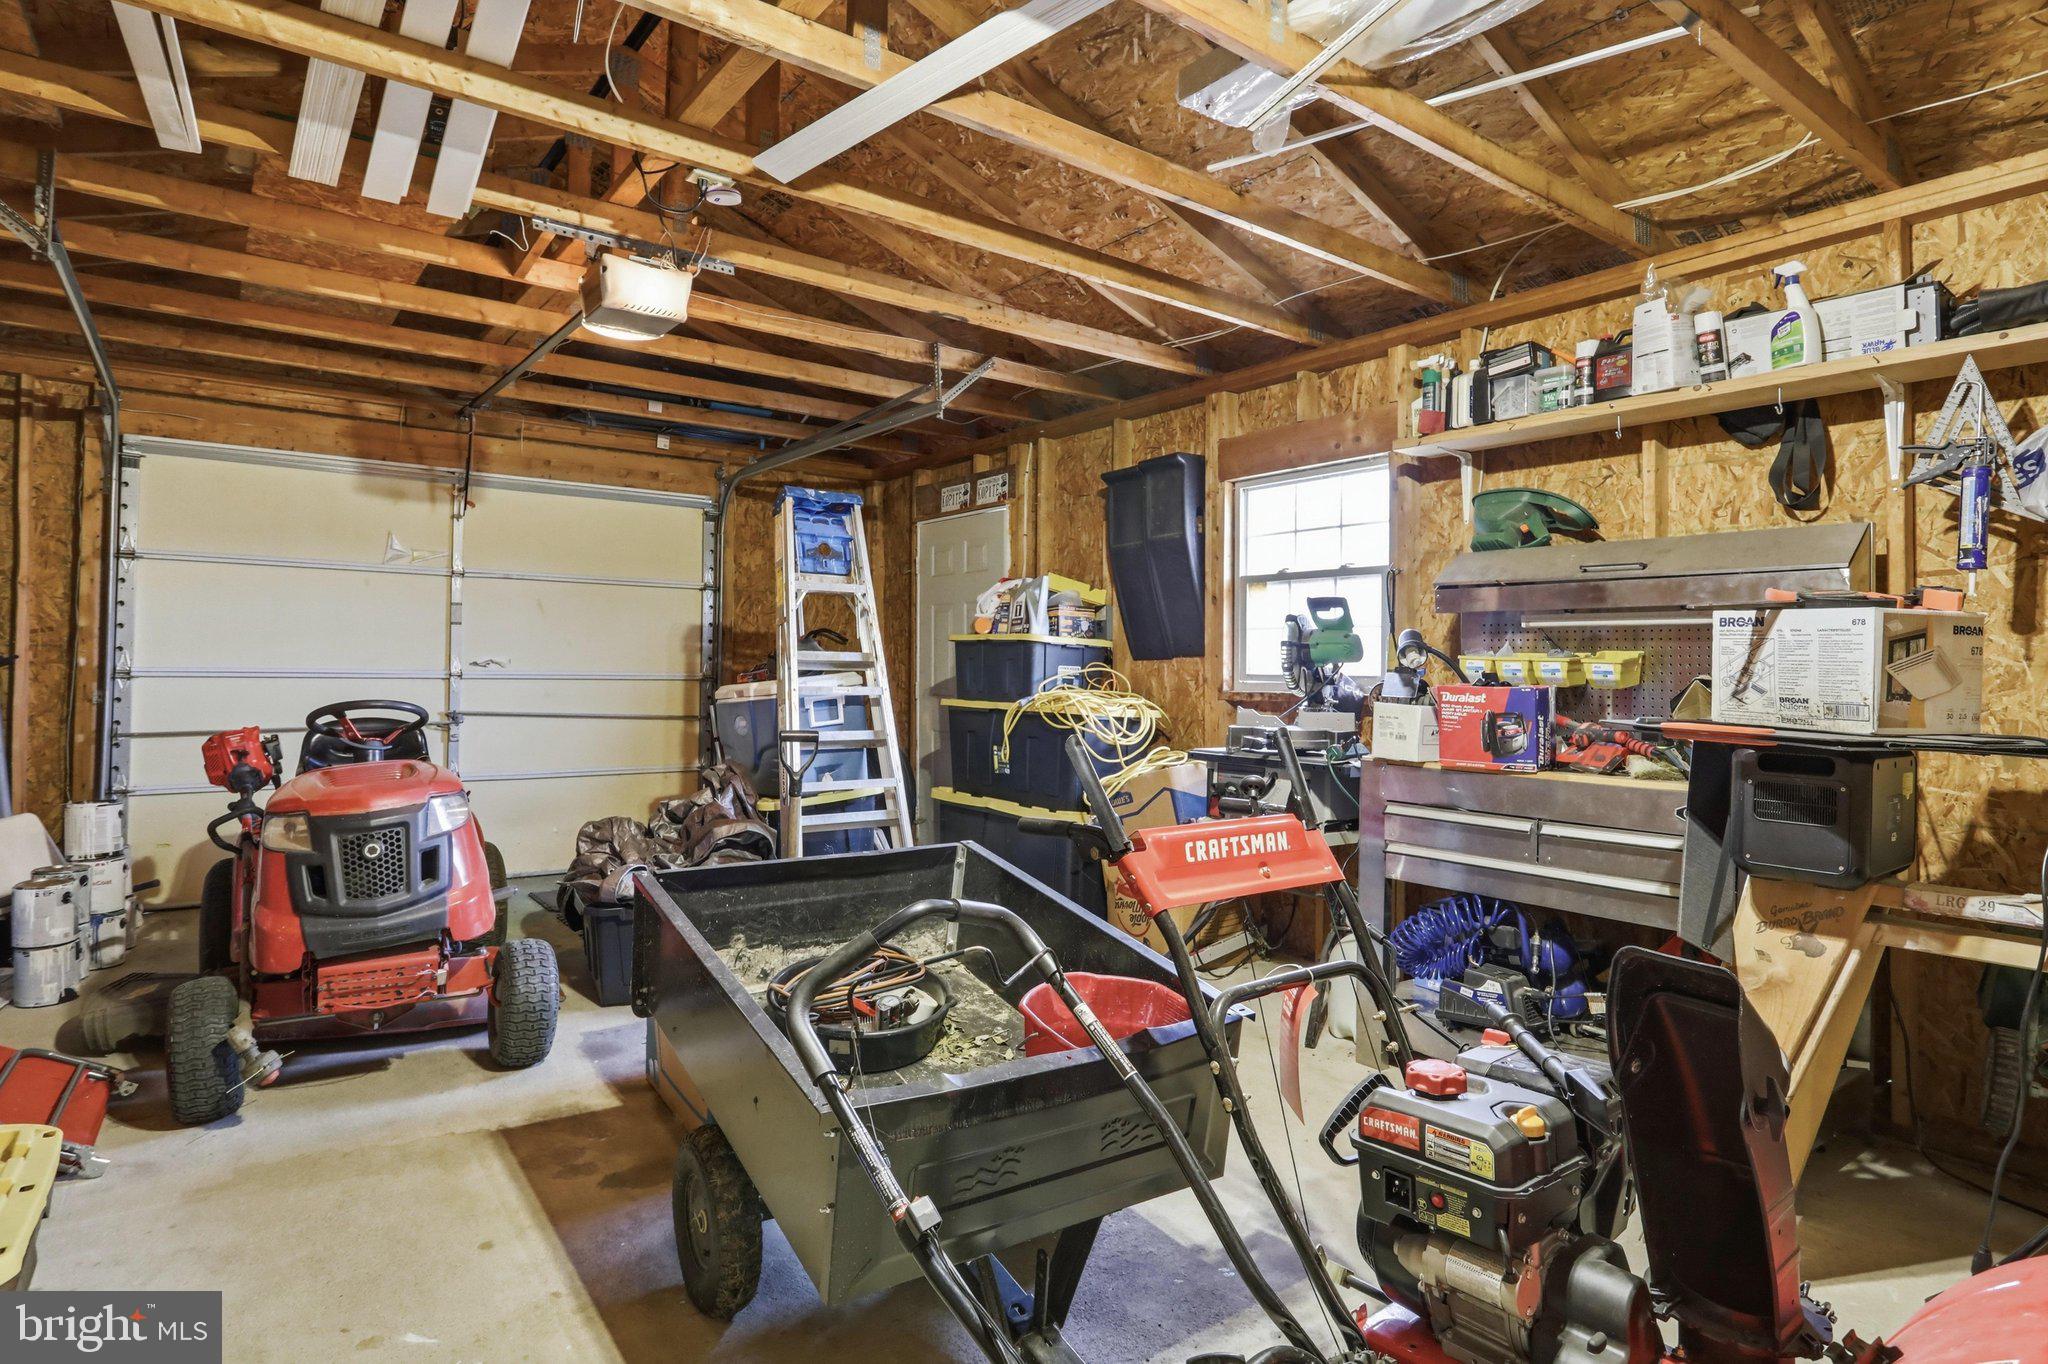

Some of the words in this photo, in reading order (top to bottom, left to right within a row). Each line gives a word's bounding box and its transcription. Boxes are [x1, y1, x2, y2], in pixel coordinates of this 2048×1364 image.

[1861, 339, 1885, 348] HAWK
[1862, 346, 1881, 354] BLUE
[1719, 616, 1765, 628] BROAN
[1851, 618, 1867, 626] 678
[1953, 625, 1983, 636] BROAN
[1970, 646, 1983, 656] 678
[1441, 691, 1487, 703] Duralast
[1779, 697, 1810, 705] BROAN
[1185, 831, 1290, 863] CRAFTSMAN
[1936, 894, 1967, 910] LRG
[1977, 899, 1997, 913] 29
[1363, 1116, 1417, 1139] CRAFTSMAN
